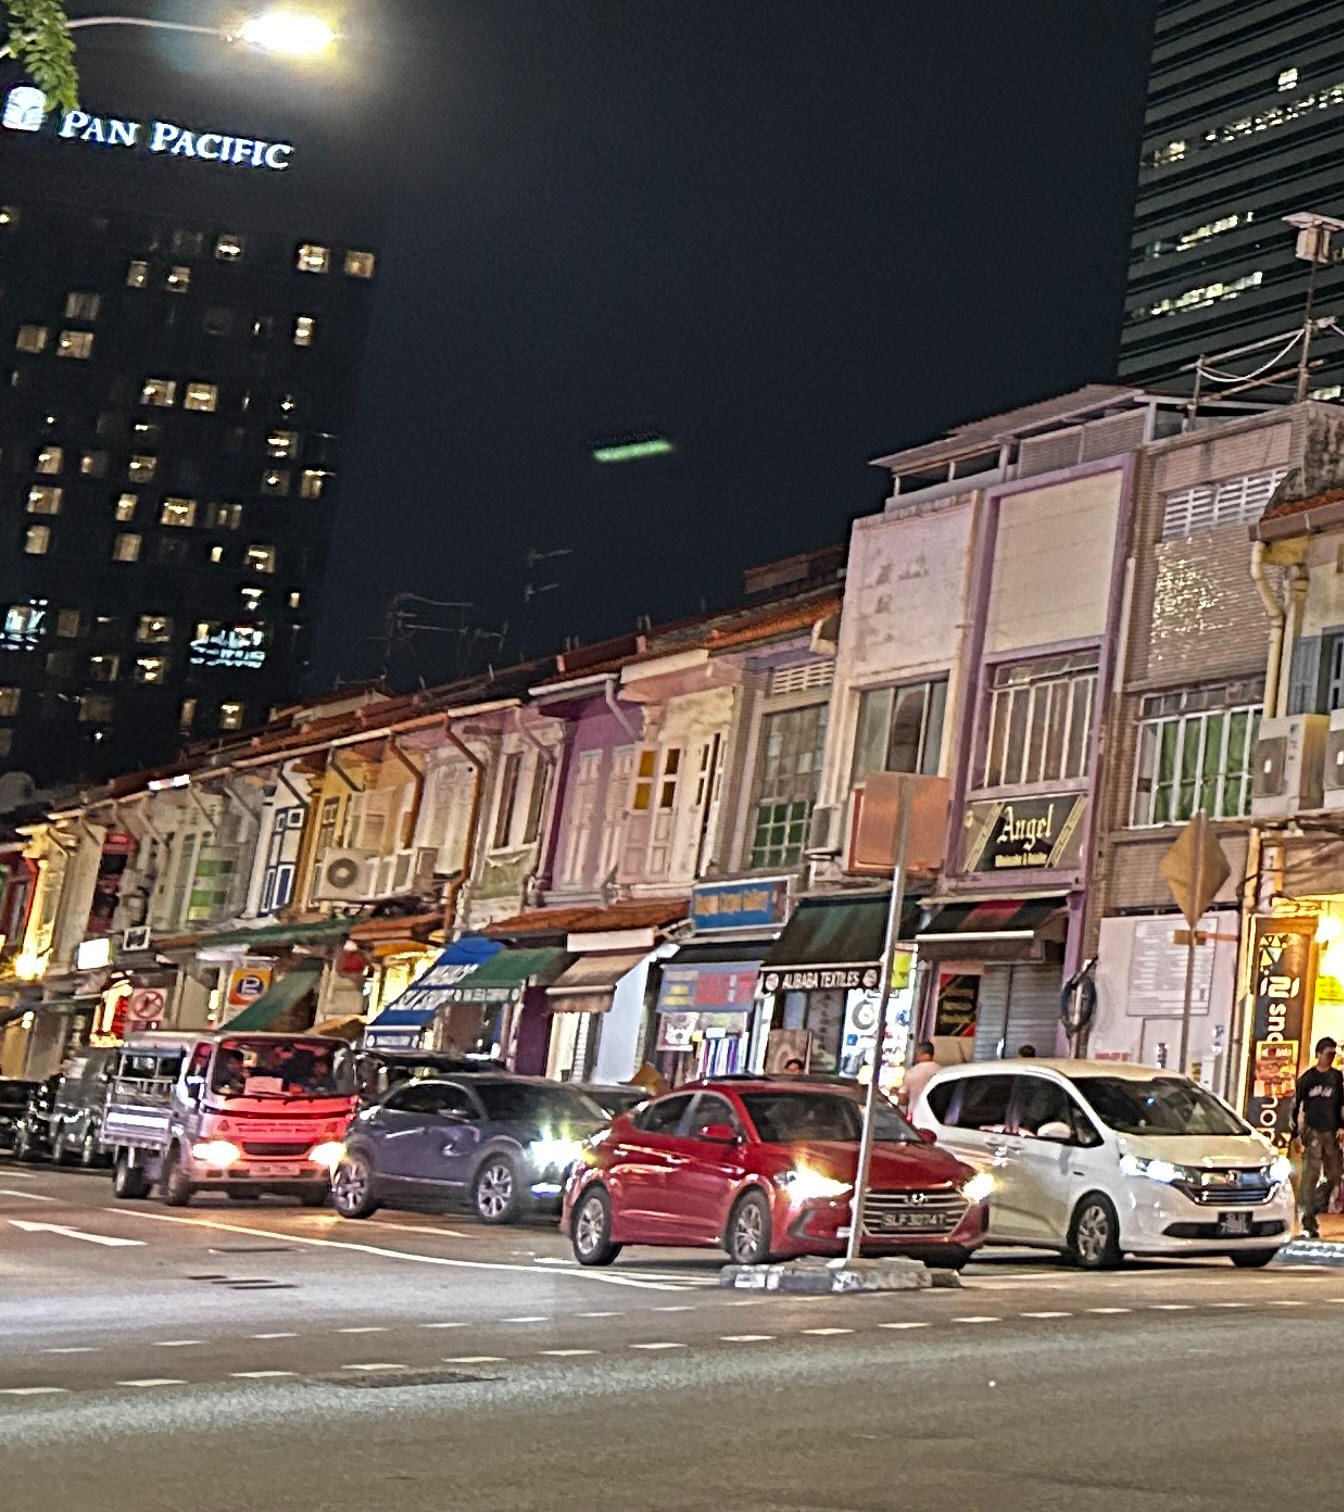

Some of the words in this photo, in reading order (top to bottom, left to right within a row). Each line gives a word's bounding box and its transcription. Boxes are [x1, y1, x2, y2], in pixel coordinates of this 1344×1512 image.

[58, 108, 141, 148] PAN
[150, 120, 294, 170] PACIFIC
[997, 803, 1054, 851] Angel
[820, 970, 861, 988] TEXTILES
